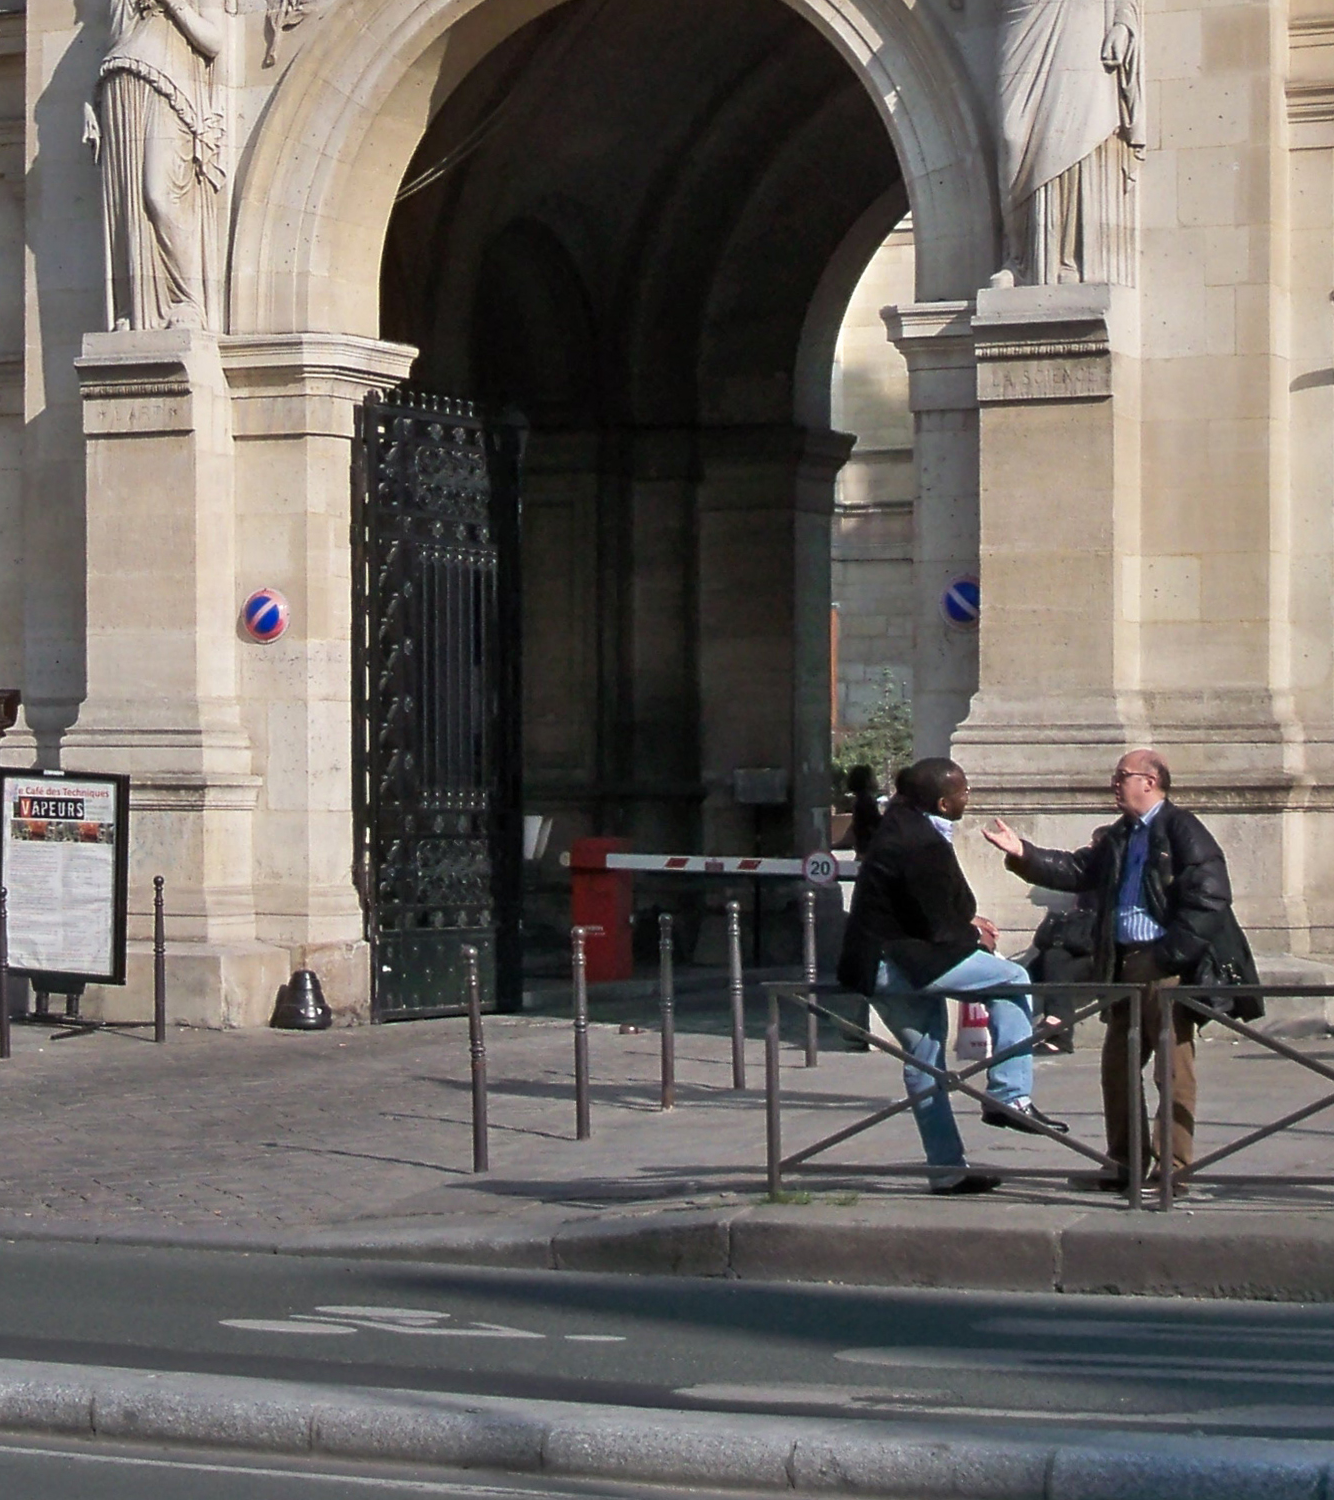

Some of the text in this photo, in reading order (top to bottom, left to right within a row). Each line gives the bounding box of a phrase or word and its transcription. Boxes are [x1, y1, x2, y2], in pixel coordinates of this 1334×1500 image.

[25, 786, 44, 795] Café
[46, 787, 61, 796] des
[63, 787, 110, 798] Techniques
[20, 798, 84, 818] VAPEURS
[810, 860, 831, 876] 20
